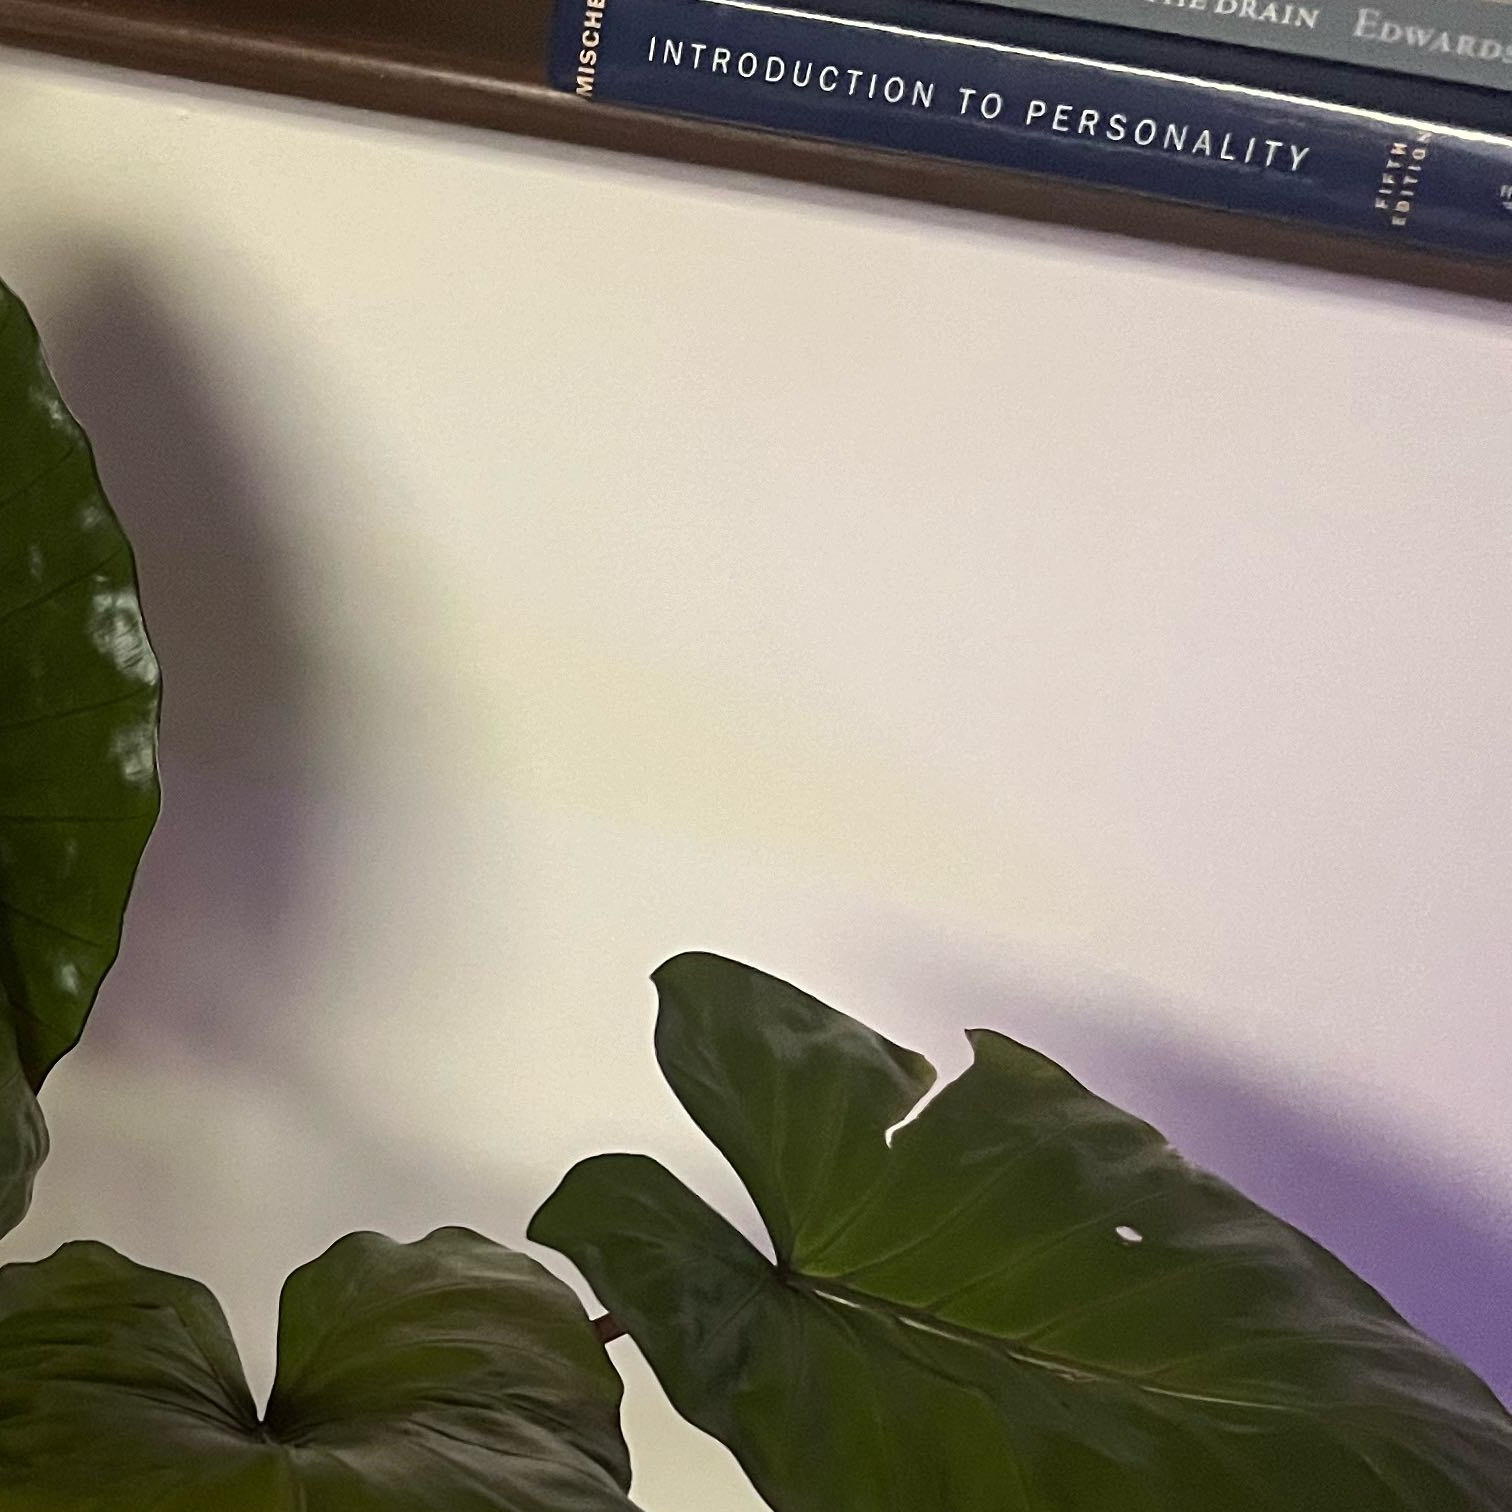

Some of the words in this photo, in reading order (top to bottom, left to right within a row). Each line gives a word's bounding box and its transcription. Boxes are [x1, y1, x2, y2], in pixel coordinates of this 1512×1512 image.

[649, 36, 936, 109] INTRODUCTION
[957, 87, 1002, 121] TO
[1026, 98, 1311, 172] PERSONALITY
[1375, 142, 1408, 209] FIFTH
[1391, 132, 1433, 226] EDITION
